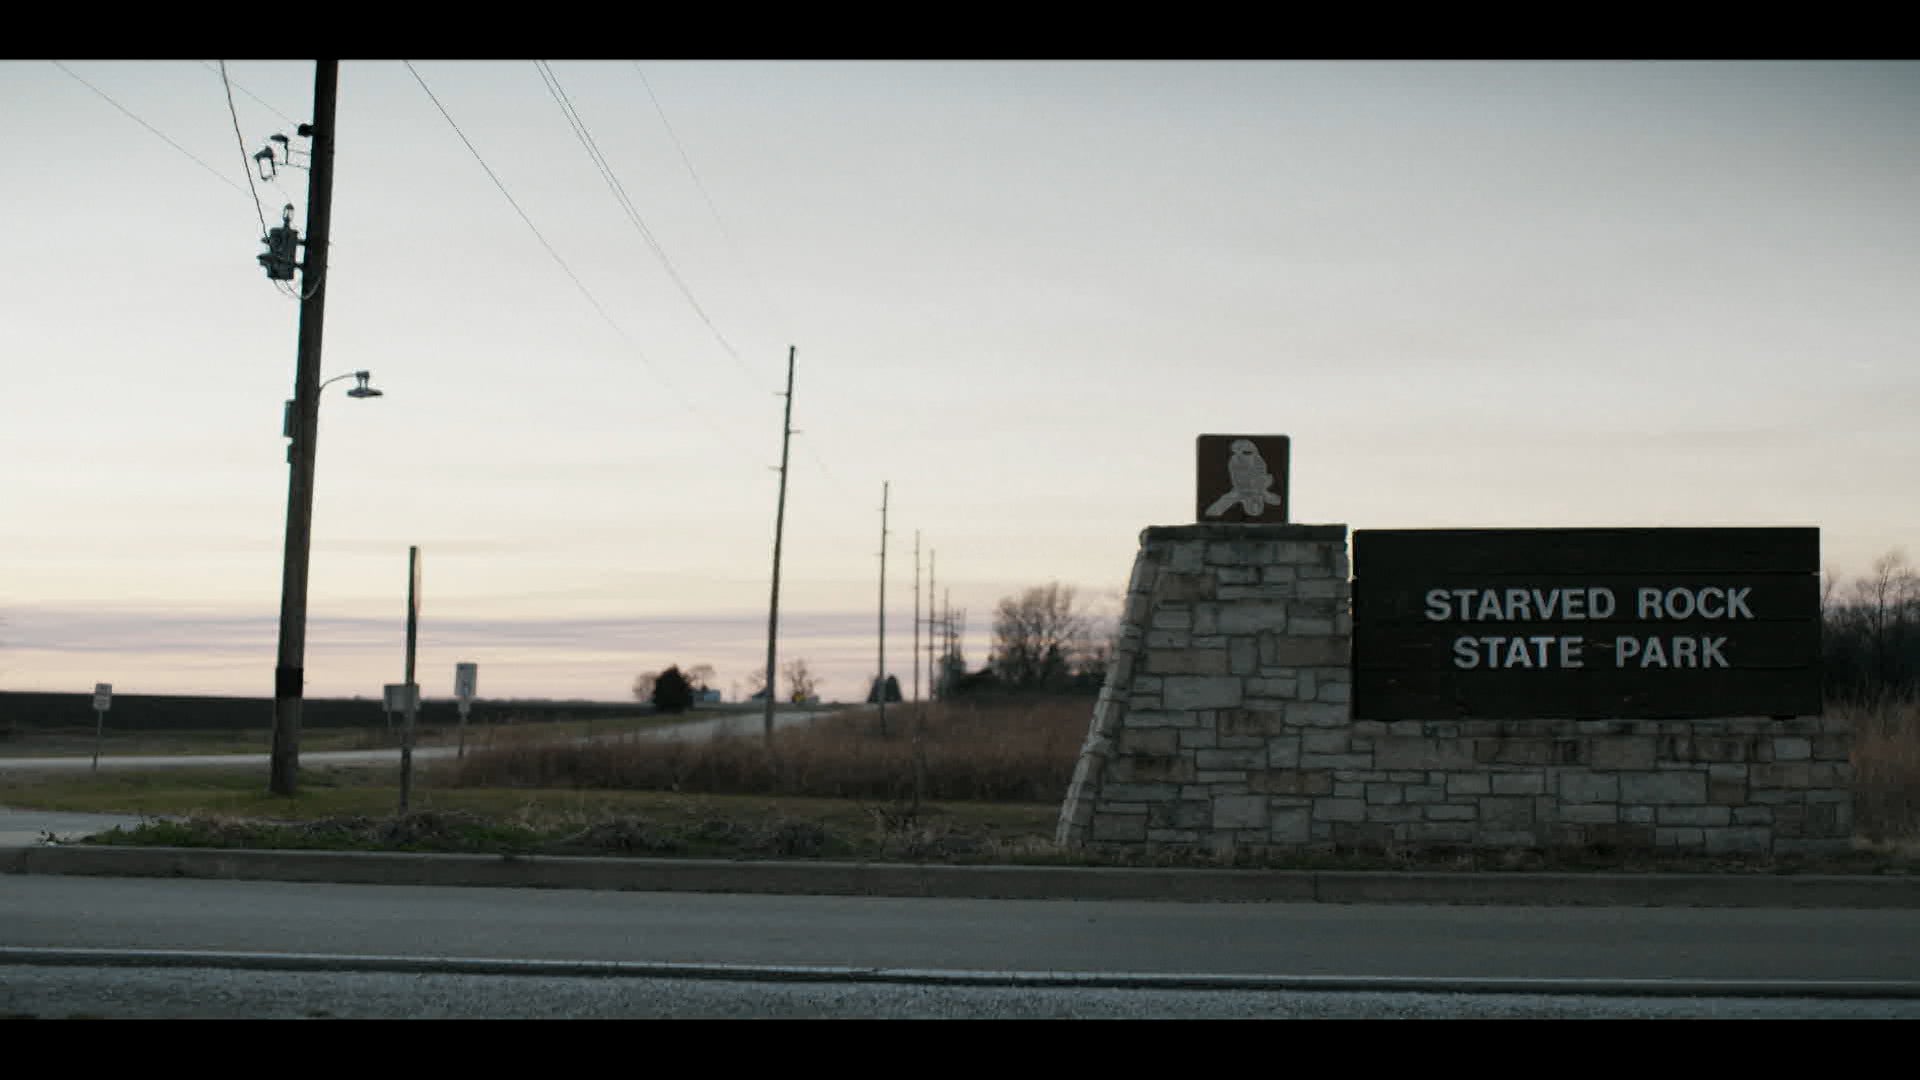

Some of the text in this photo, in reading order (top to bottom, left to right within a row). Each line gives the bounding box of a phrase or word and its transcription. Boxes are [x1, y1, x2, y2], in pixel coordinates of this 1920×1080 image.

[1425, 587, 1755, 621] STARVED ROCK
[1453, 636, 1730, 669] STATE PARK
